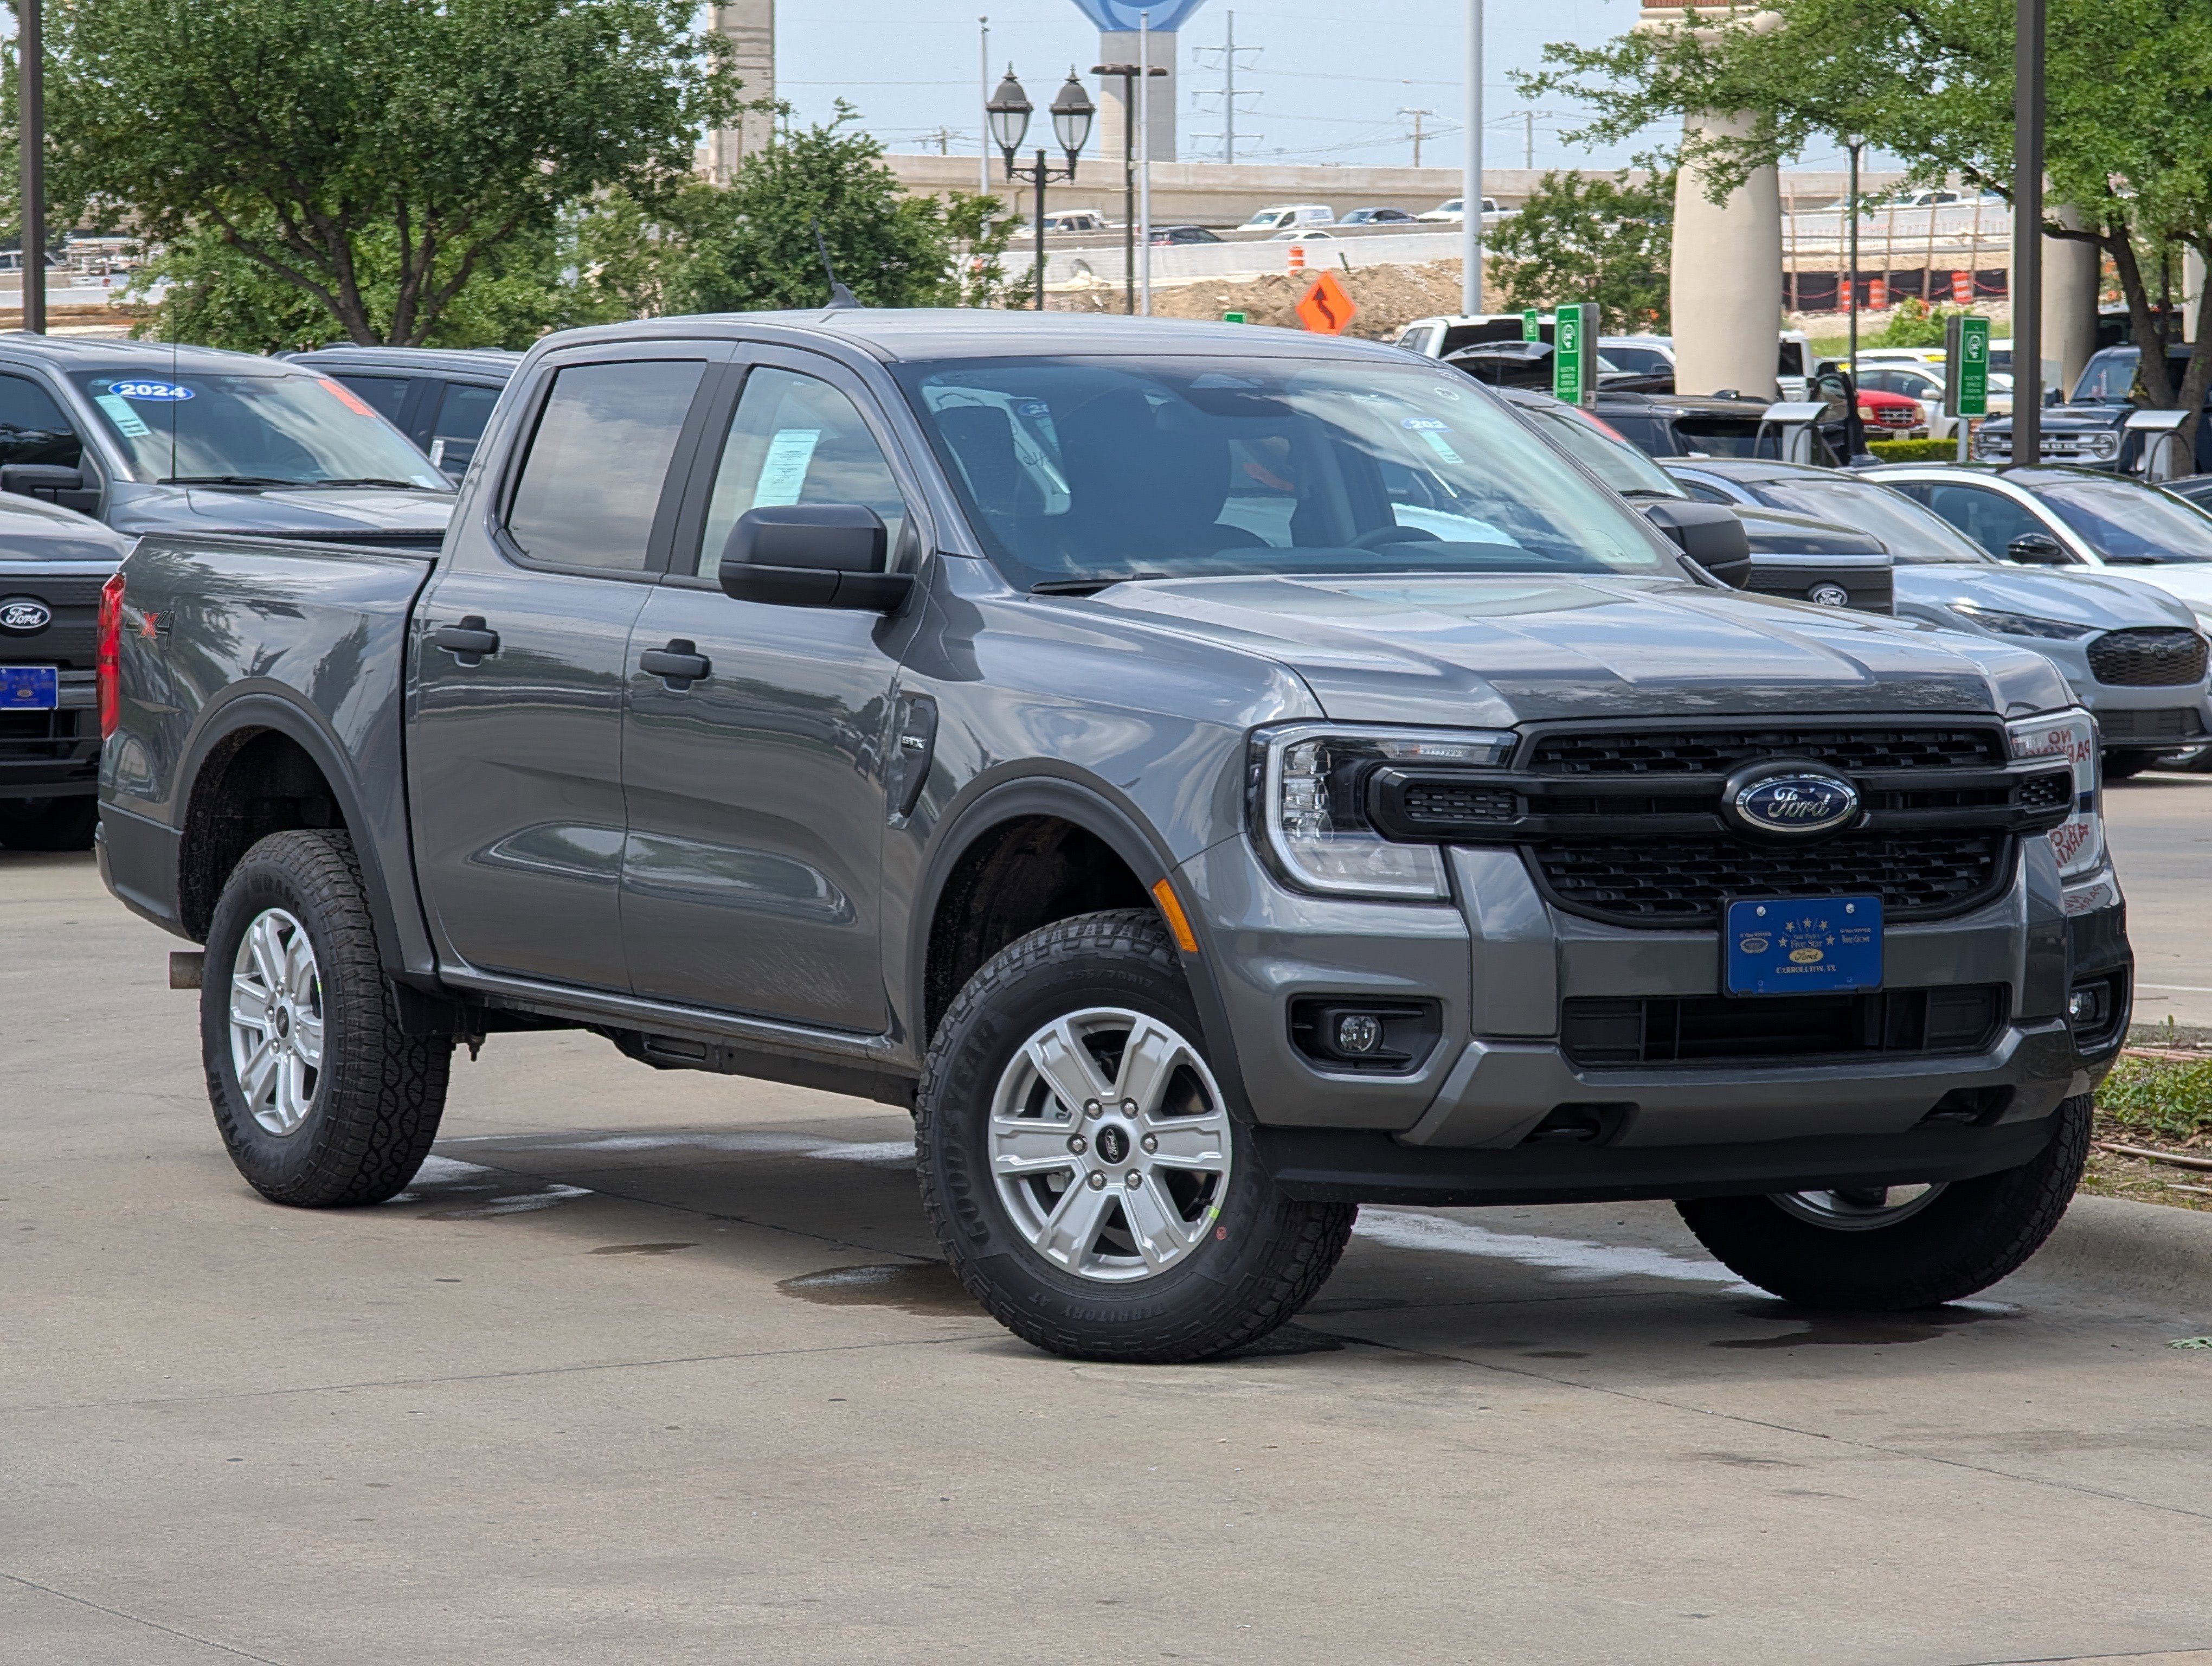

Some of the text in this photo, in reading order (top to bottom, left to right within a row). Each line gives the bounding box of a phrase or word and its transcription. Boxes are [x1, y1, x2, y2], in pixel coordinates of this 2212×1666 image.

[119, 384, 187, 398] 2024
[1410, 420, 1449, 429] 202
[6, 606, 42, 624] Ford
[901, 735, 927, 748] STX
[1768, 787, 1831, 818] Ford
[1808, 940, 1822, 948] Star
[1795, 950, 1818, 961] Ford
[1059, 1302, 1166, 1322] TERRITORY
